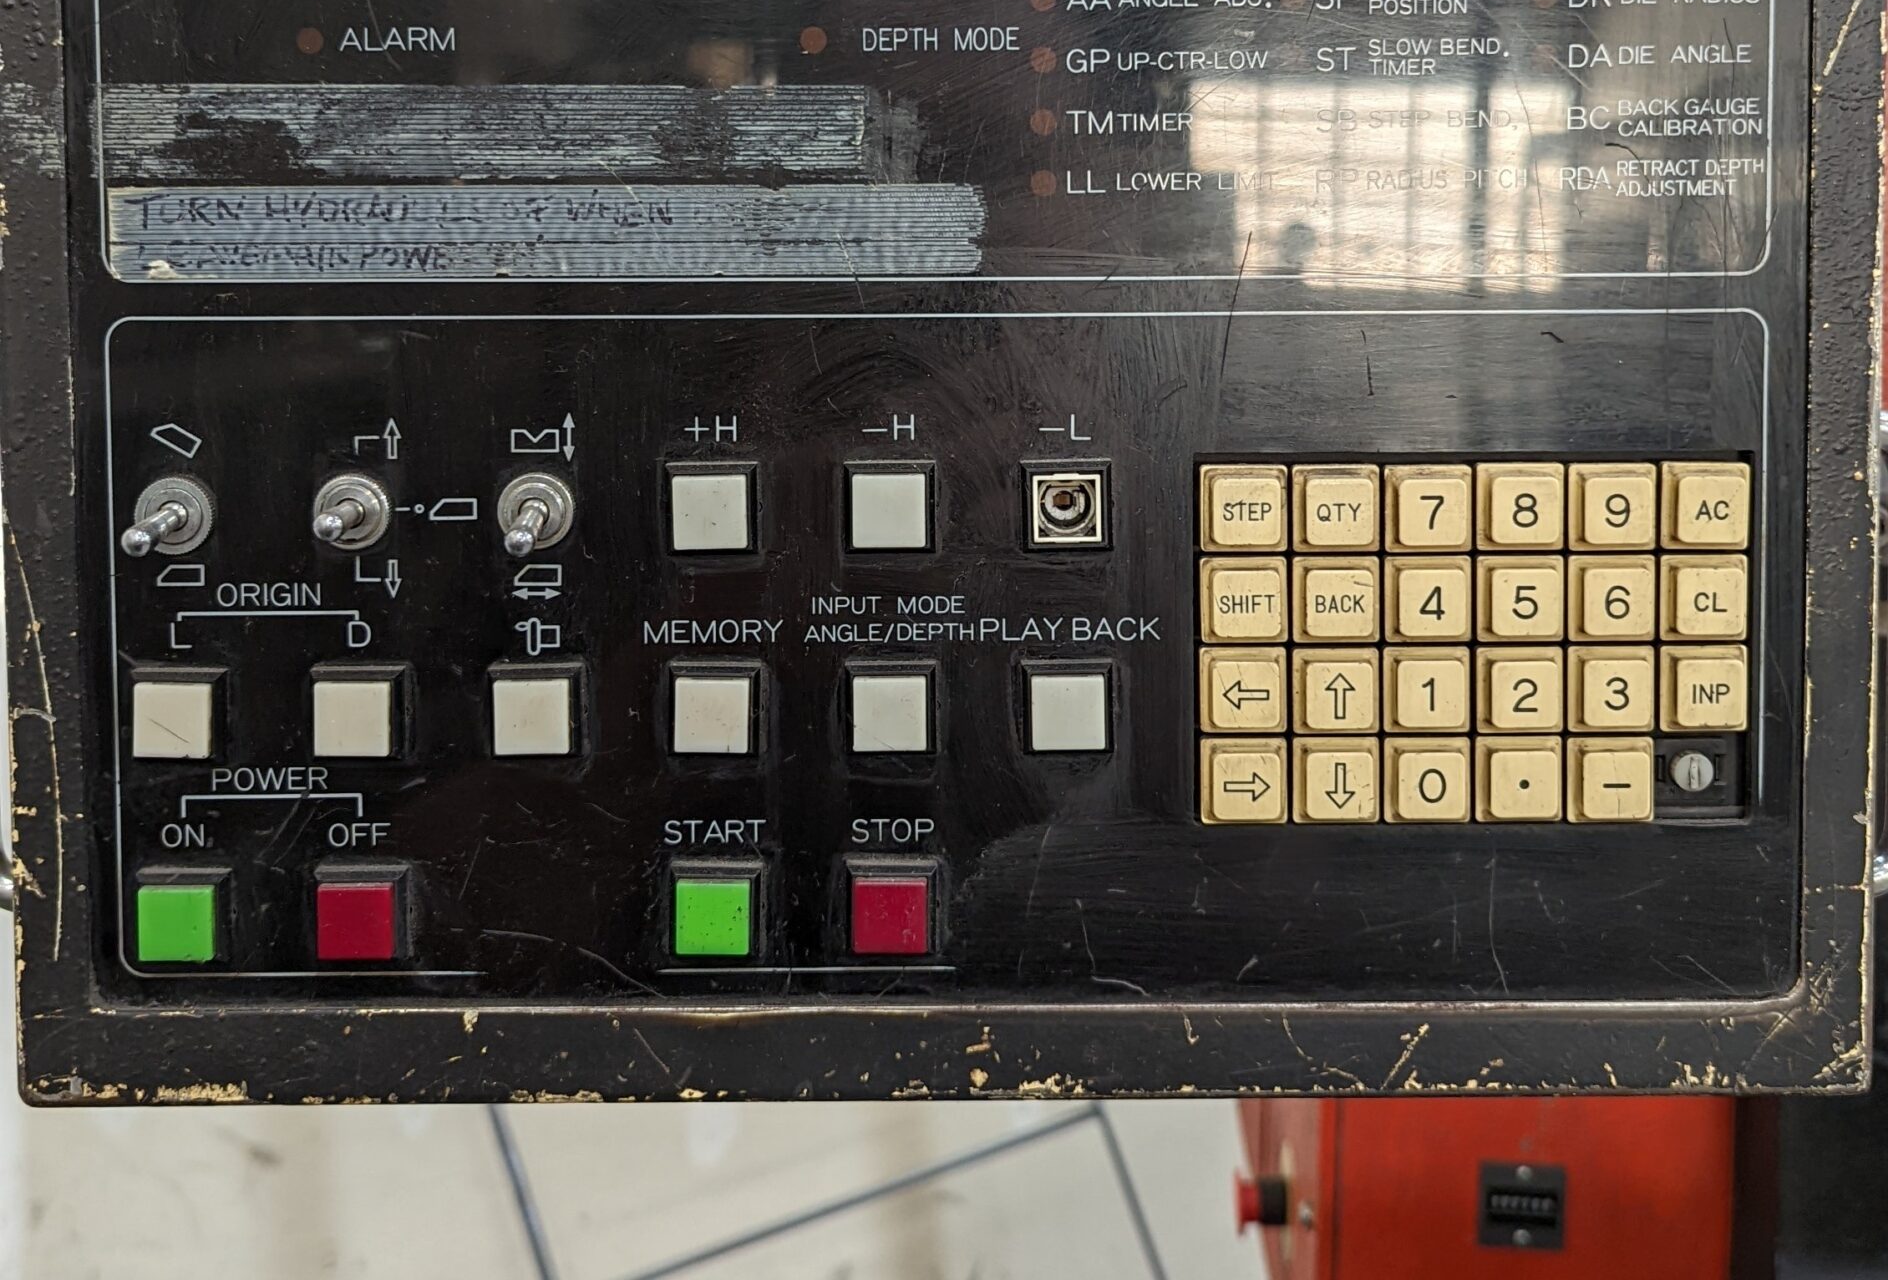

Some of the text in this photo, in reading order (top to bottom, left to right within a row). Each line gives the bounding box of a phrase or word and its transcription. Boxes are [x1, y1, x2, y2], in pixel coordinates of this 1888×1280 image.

[339, 27, 457, 53] ALARM
[862, 27, 1021, 52] DEPTH MODE
[1368, 37, 1509, 58] SLOW BEND.
[1066, 48, 1268, 73] GP UP-CTR-LOW
[1315, 47, 1357, 71] ST
[1368, 58, 1436, 76] TIMER
[1568, 44, 1752, 68] DA DIE ANGLE
[1567, 106, 1610, 130] BC
[1618, 97, 1760, 116] BACK GAUGE
[1066, 110, 1193, 134] TM TIMER
[1316, 108, 1357, 133] SB
[1368, 109, 1431, 129] STEP
[1617, 117, 1762, 137] CALIBRATION
[1560, 167, 1611, 191] RDA
[1616, 158, 1764, 177] RETRACT DEPTH
[1066, 170, 1280, 194] LL LOWER LIMIT
[1315, 169, 1358, 193] RP
[1464, 168, 1527, 189] PITCH
[1616, 178, 1737, 197] ADJUSTMENT
[1222, 503, 1272, 522] STEP
[1316, 503, 1361, 523] QTY
[1419, 495, 1445, 530] 7
[1511, 493, 1539, 528] 8
[1604, 493, 1631, 528] 9
[1695, 501, 1730, 520] AC
[216, 583, 322, 607] ORIGIN
[811, 596, 965, 615] INPUT MODE
[1219, 594, 1275, 614] SHIFT
[1315, 594, 1365, 614] BACK
[1419, 586, 1445, 620] 4
[1511, 585, 1539, 619] 5
[1604, 585, 1631, 619] 6
[1694, 593, 1728, 612] CL
[170, 622, 192, 649] L
[348, 621, 371, 648] D
[643, 619, 783, 644] MEMORY
[804, 623, 975, 643] ANGLE/DEPTH
[978, 617, 1161, 642] PLAY BACK
[1421, 677, 1436, 712] 1
[1512, 678, 1538, 712] 2
[1604, 677, 1630, 710] 3
[1692, 684, 1730, 704] INP
[211, 767, 328, 790] POWER
[161, 824, 205, 847] ON
[328, 823, 391, 847] OFF
[664, 820, 766, 844] START
[851, 819, 934, 843] STOP
